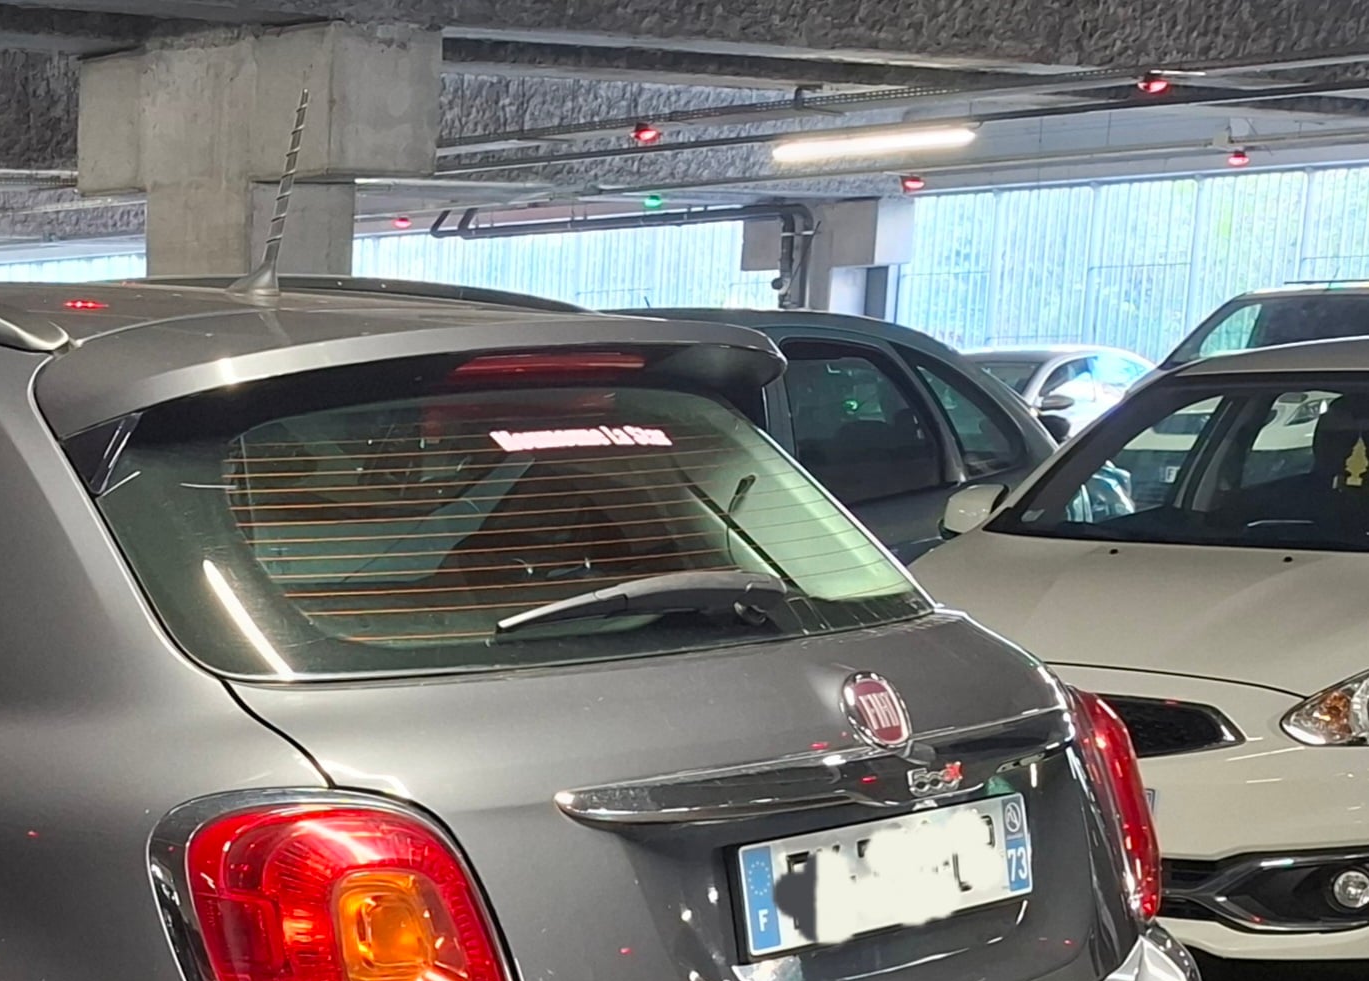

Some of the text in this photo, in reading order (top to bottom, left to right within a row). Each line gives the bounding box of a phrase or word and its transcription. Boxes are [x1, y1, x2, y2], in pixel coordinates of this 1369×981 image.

[857, 690, 902, 731] FIAT
[1006, 846, 1029, 882] 73
[757, 908, 770, 932] F
